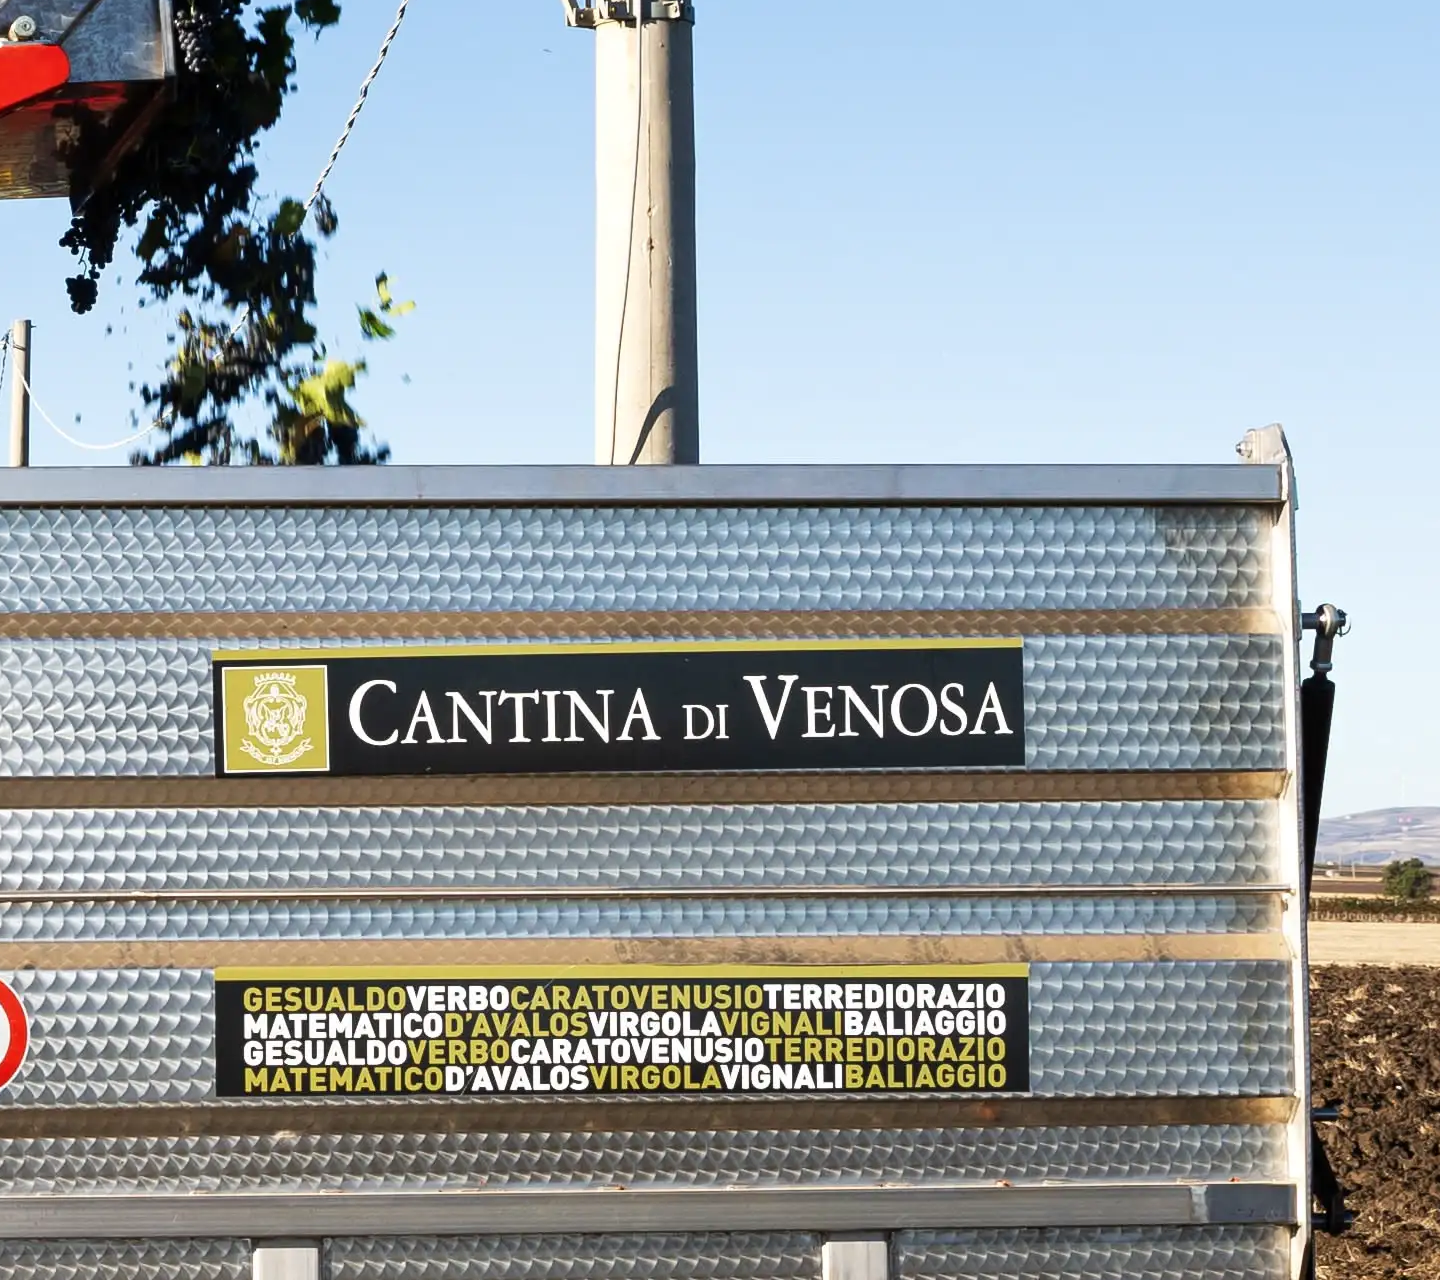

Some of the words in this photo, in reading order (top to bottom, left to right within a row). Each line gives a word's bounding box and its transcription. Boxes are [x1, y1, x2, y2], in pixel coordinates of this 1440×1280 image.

[349, 678, 662, 746] CANTINA
[682, 704, 730, 740] DI
[742, 673, 1014, 741] VENOSA
